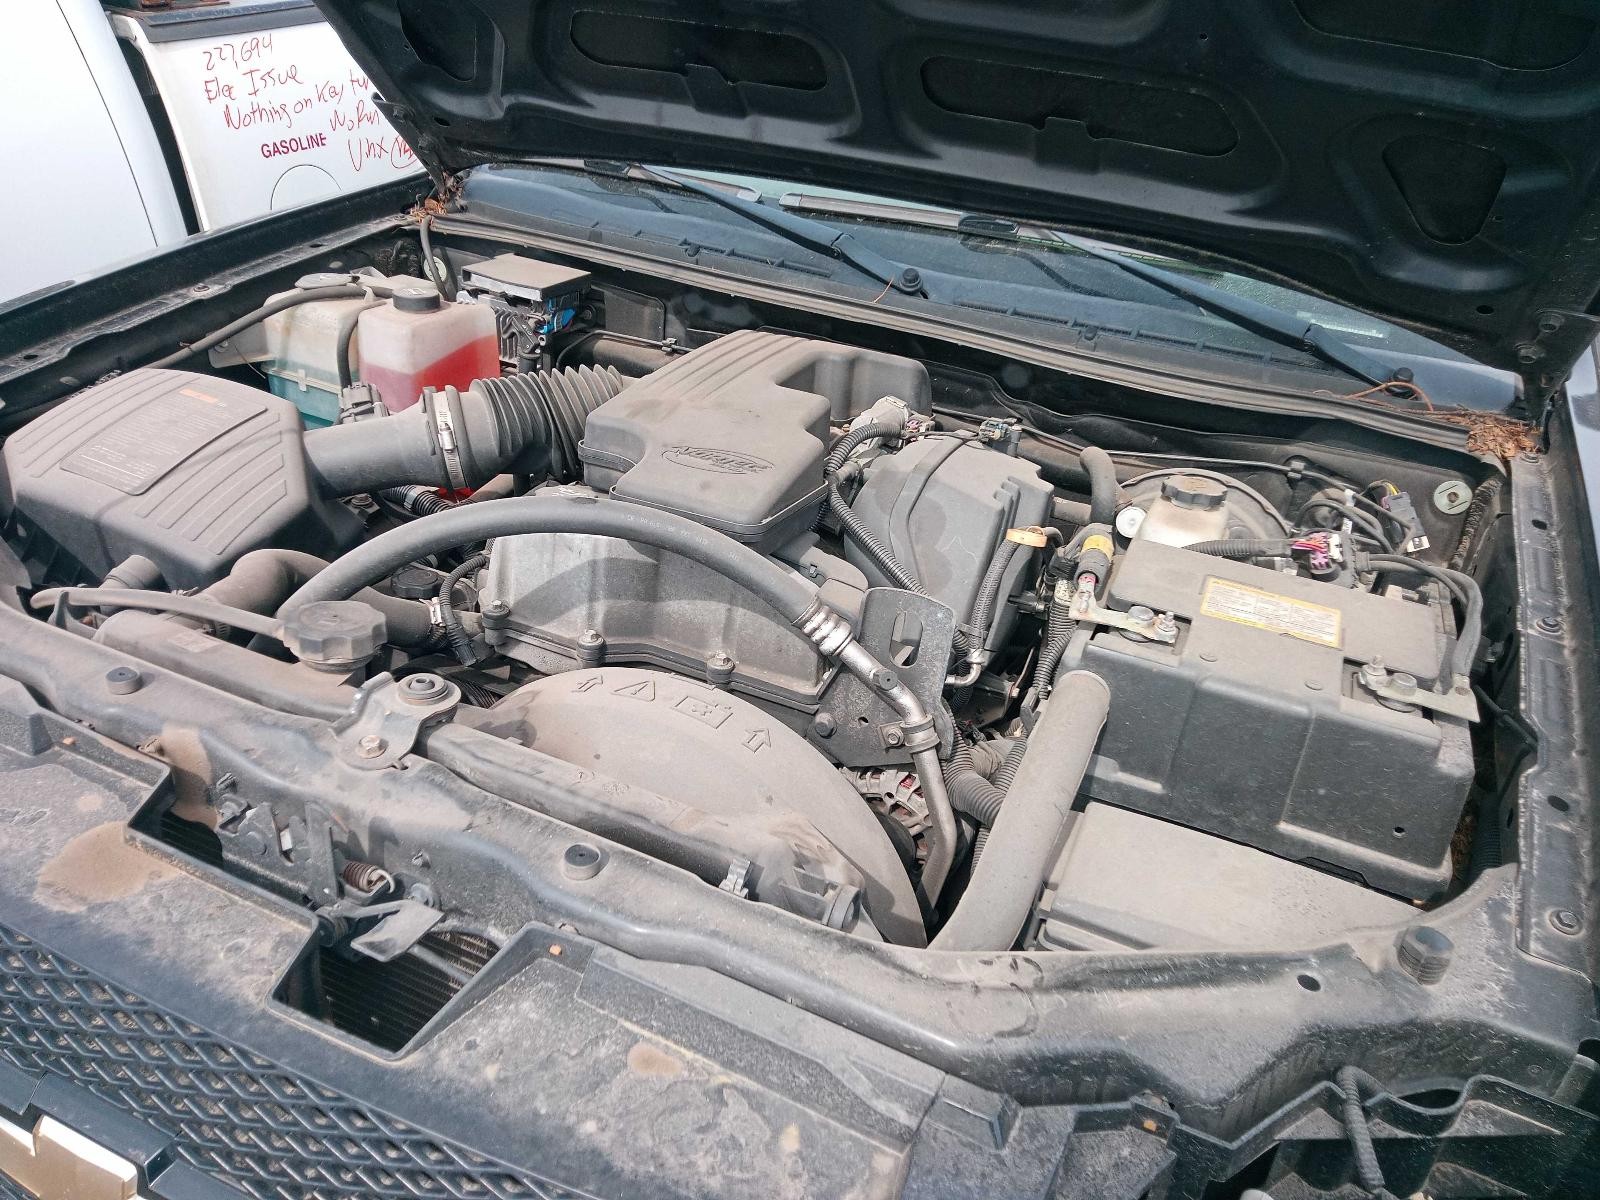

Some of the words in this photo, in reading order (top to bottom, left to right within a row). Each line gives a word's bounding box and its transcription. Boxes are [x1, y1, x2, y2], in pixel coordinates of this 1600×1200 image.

[242, 64, 304, 96] Issue
[223, 100, 293, 130] Nothing
[293, 98, 313, 114] on
[315, 80, 344, 105] Key
[260, 132, 327, 159] GASOLINE
